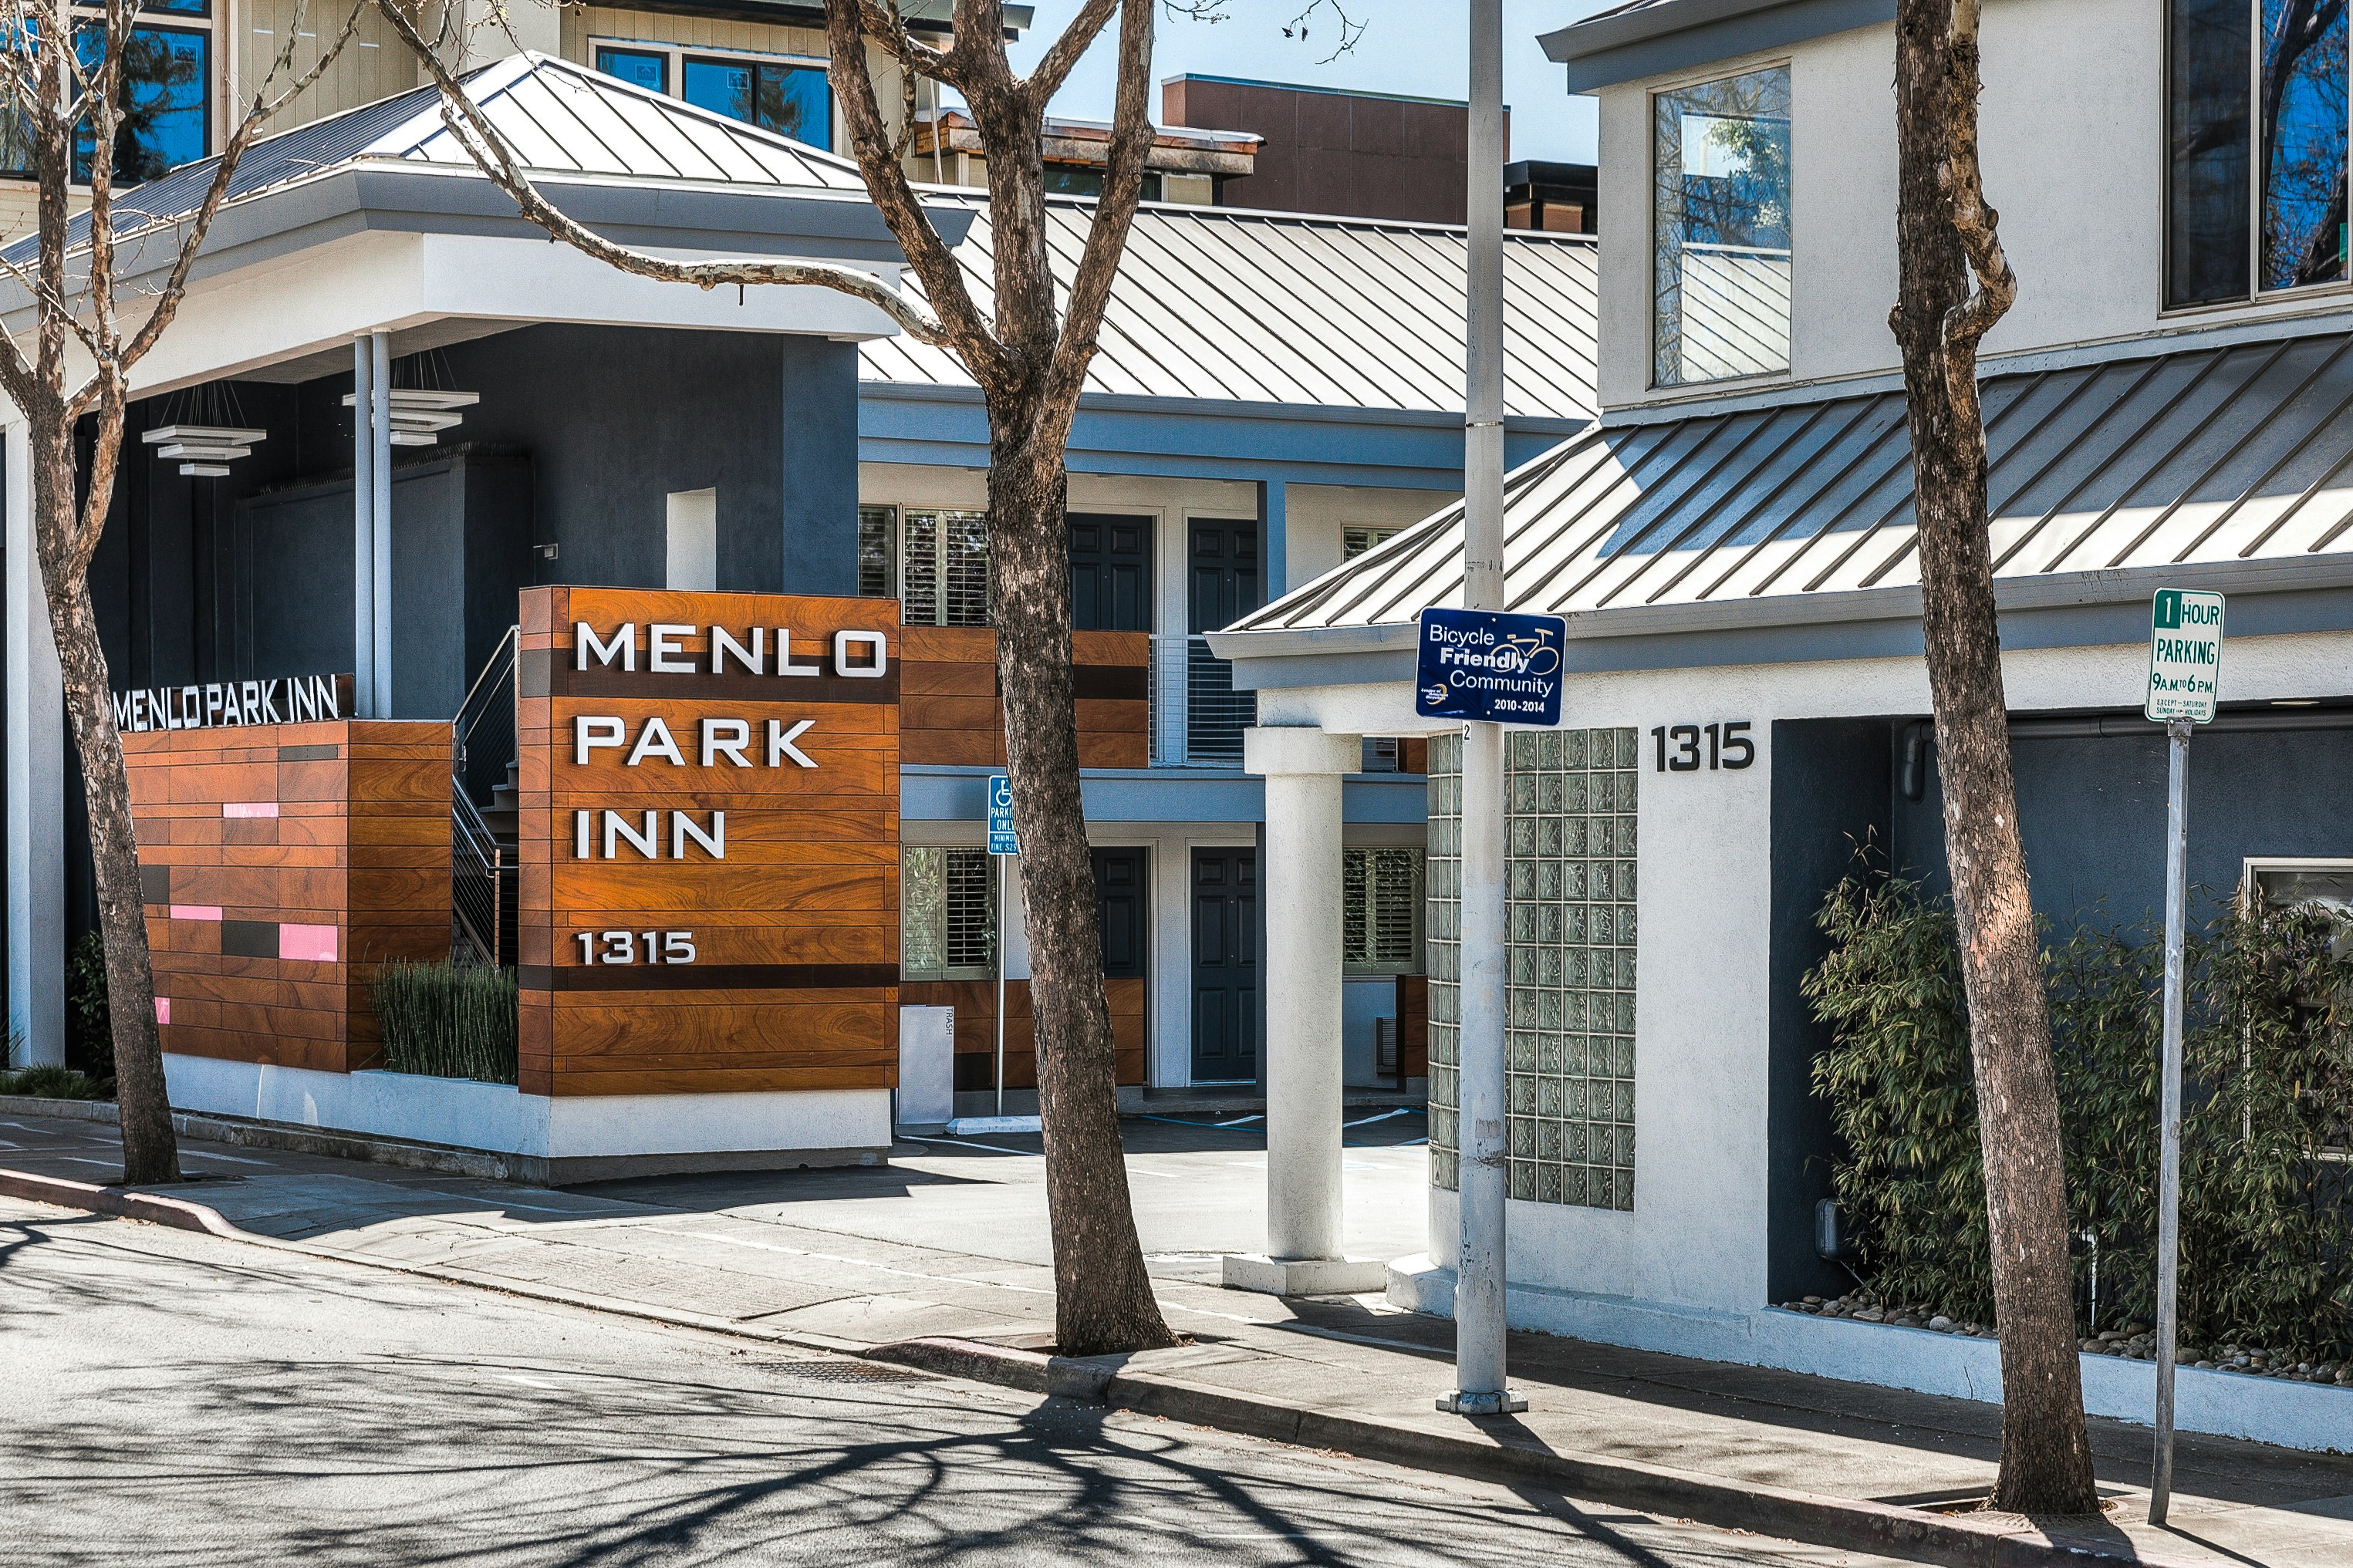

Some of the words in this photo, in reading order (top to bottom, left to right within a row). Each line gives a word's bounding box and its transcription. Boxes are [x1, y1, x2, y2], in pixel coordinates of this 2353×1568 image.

[2166, 596, 2172, 623] 1
[2181, 603, 2220, 626] HOUR
[1430, 624, 1495, 647] Bicycle
[575, 622, 886, 678] MENLO
[1440, 646, 1530, 674] Friendly
[2156, 638, 2215, 665] PARKING
[1450, 669, 1554, 698] Community
[2179, 679, 2187, 688] TO
[113, 685, 200, 731] MENLO
[206, 678, 282, 727] PARK
[287, 673, 339, 722] INN
[1494, 699, 1545, 713] 2010-2014
[2184, 708, 2206, 717] HOLIDAYS
[572, 715, 819, 768] PARK
[1463, 723, 1470, 740] 2
[1650, 720, 1755, 773] 1315
[991, 807, 1012, 818] PARKI
[573, 809, 725, 860] INN
[991, 842, 1002, 851] FINE
[1004, 843, 1017, 851] $25
[576, 930, 697, 966] 1315
